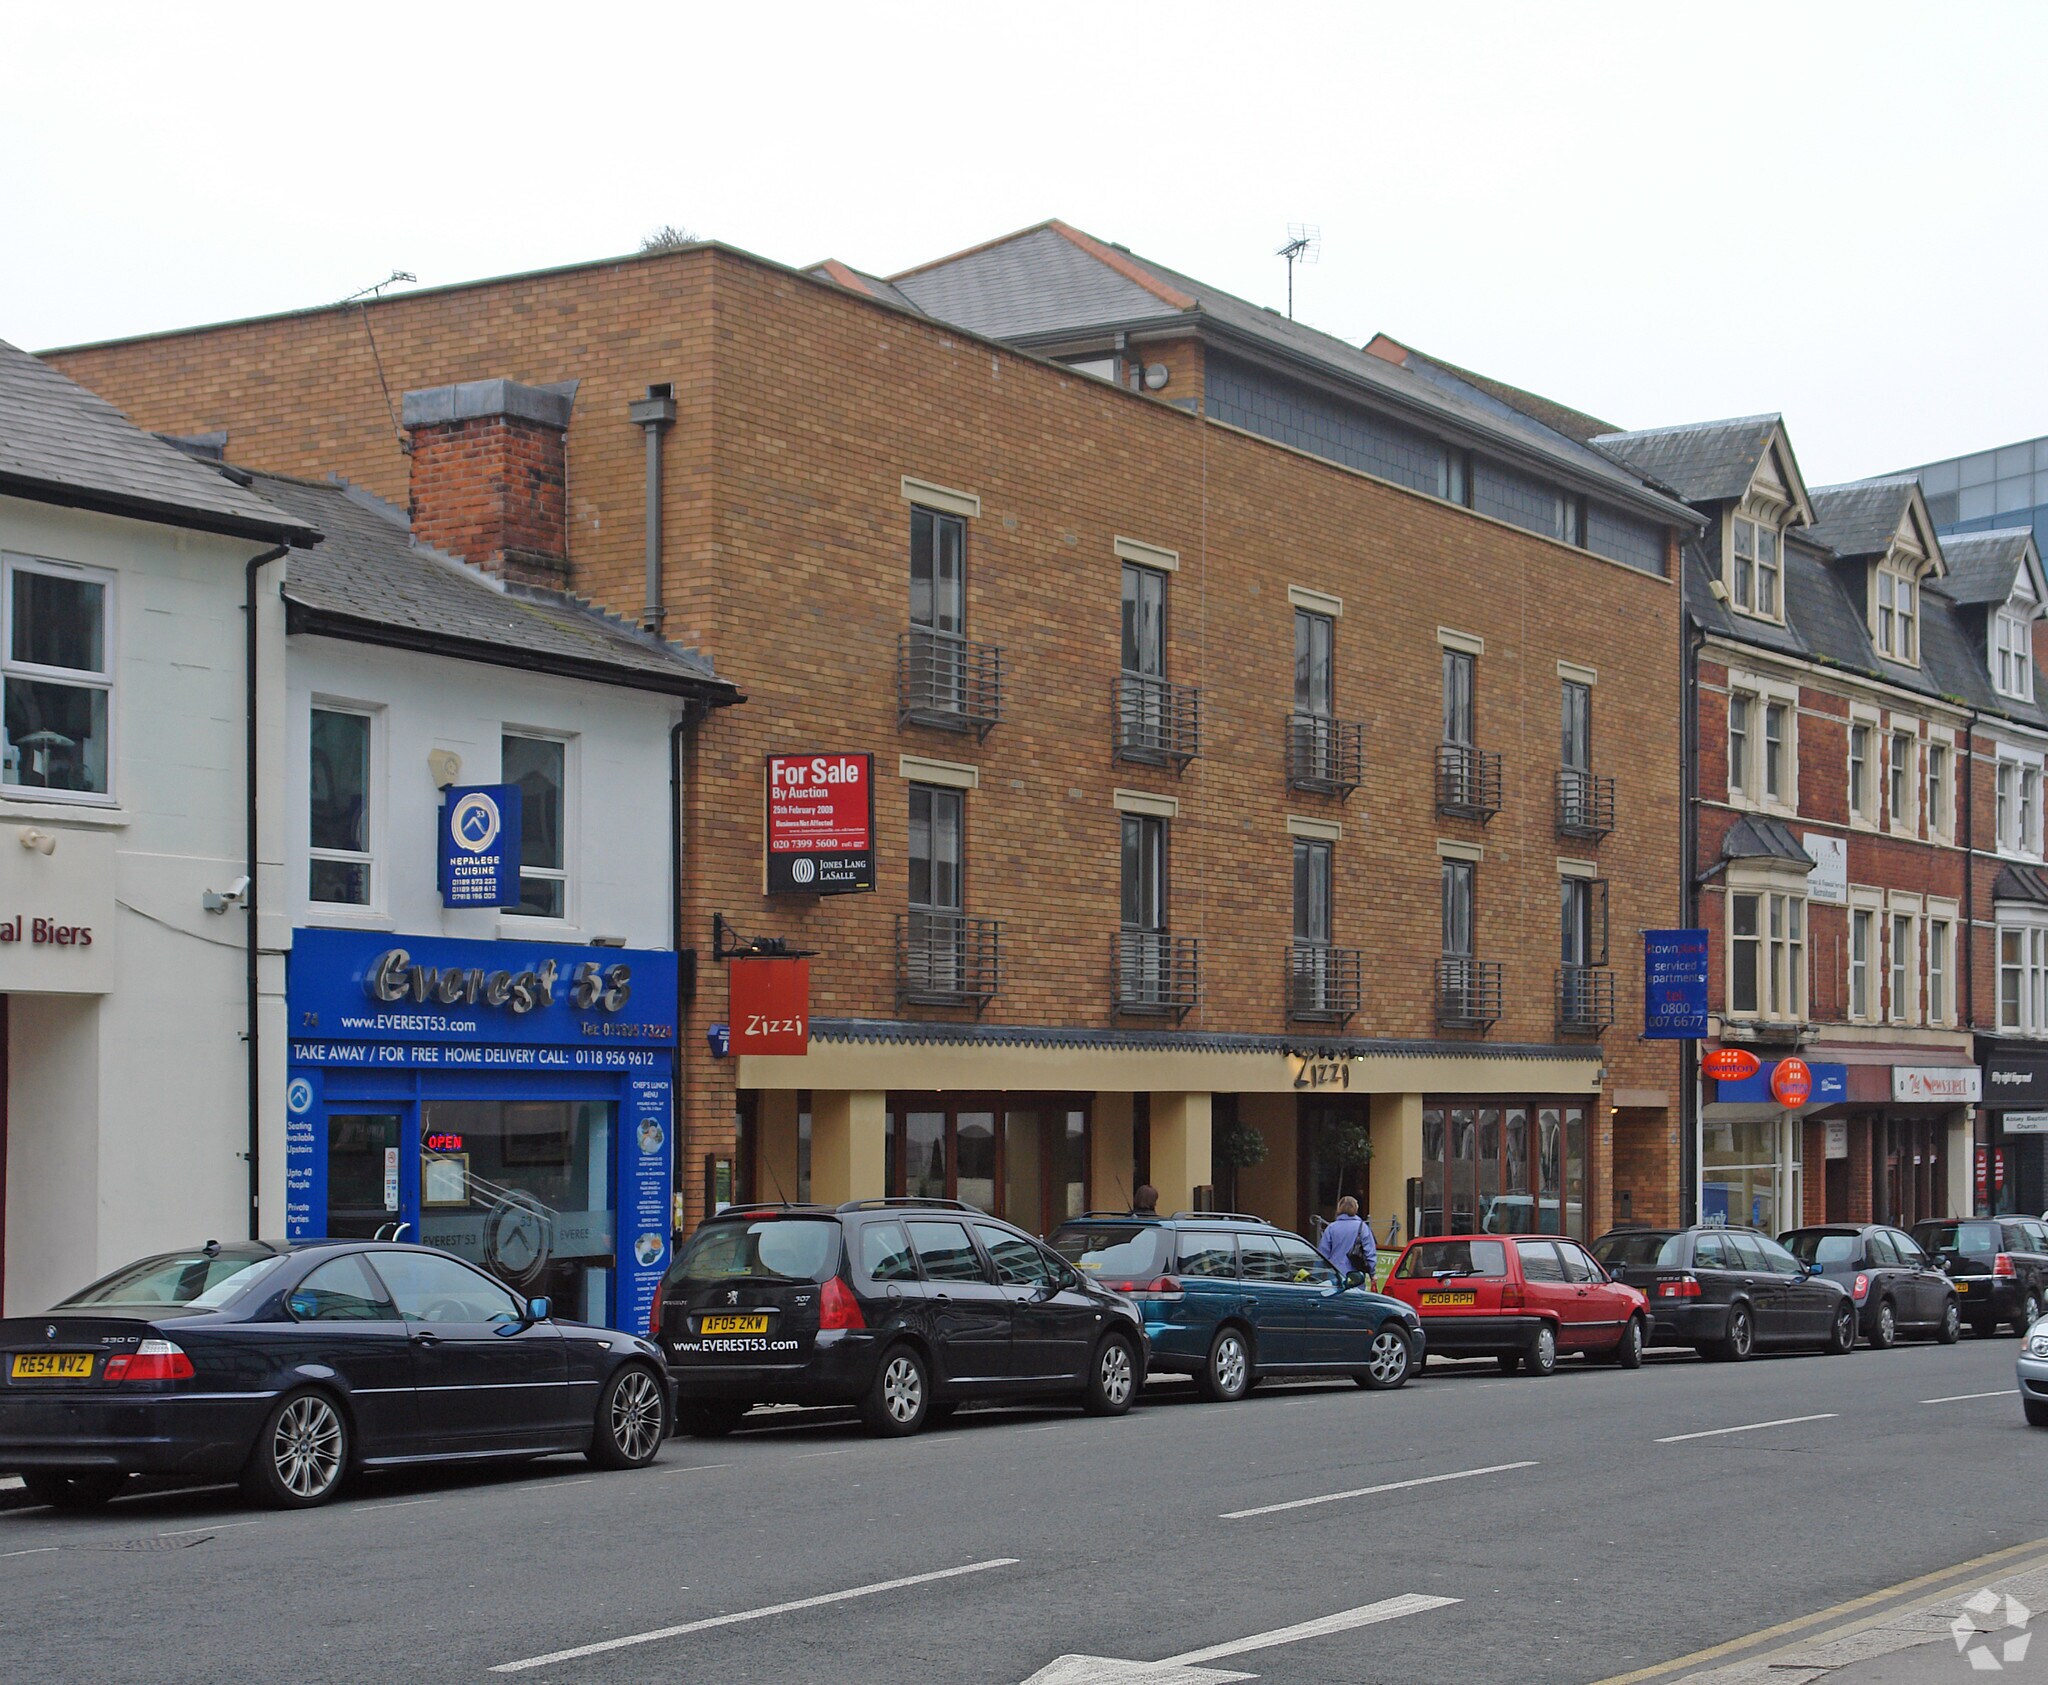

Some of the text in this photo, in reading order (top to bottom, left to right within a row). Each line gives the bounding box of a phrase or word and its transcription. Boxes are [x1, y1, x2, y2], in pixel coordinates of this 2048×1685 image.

[772, 758, 859, 785] For Sale
[772, 786, 828, 800] By Auction
[788, 805, 816, 815] February
[773, 840, 789, 849] 020
[815, 839, 838, 848] 5600
[450, 856, 499, 865] NEPALESE
[820, 858, 866, 870] JONES LANG
[455, 867, 495, 875] CUISINE
[32, 917, 93, 946] Biers
[1655, 961, 1697, 971] serviced
[372, 949, 631, 1014] Everest 53
[1648, 973, 1705, 984] apartments
[1661, 1003, 1690, 1014] 0800
[341, 1014, 476, 1032] www.EVEREST53.com
[745, 1015, 802, 1036] Zizzi
[1649, 1015, 1703, 1027] 007 6677
[294, 1044, 325, 1059] TAKE
[329, 1045, 366, 1061] AWAY
[379, 1047, 404, 1061] FOR
[411, 1047, 438, 1062] FREE
[445, 1048, 482, 1062] HOME
[485, 1049, 535, 1063] DELIVERY
[538, 1050, 569, 1064] CALL:
[576, 1050, 602, 1064] 0118
[606, 1051, 625, 1065] 956
[628, 1052, 654, 1065] 9612
[1707, 1064, 1753, 1073] swinton
[651, 1081, 669, 1089] LUNCH
[288, 1122, 312, 1131] Seating
[286, 1133, 314, 1142] Available
[428, 1135, 462, 1149] OPEN
[286, 1145, 313, 1155] Upstairs
[303, 1167, 312, 1176] 40
[288, 1181, 310, 1190] People
[288, 1203, 310, 1211] Private
[288, 1214, 310, 1223] Parties
[520, 1216, 532, 1227] 53
[295, 1226, 301, 1235] &
[794, 1295, 811, 1303] 307
[1425, 1294, 1473, 1304] J608 RPH
[706, 1318, 763, 1331] AF05 ZKW
[673, 1338, 798, 1352] www.EVEREST53.com
[19, 1355, 87, 1373] RE54 WVZ
